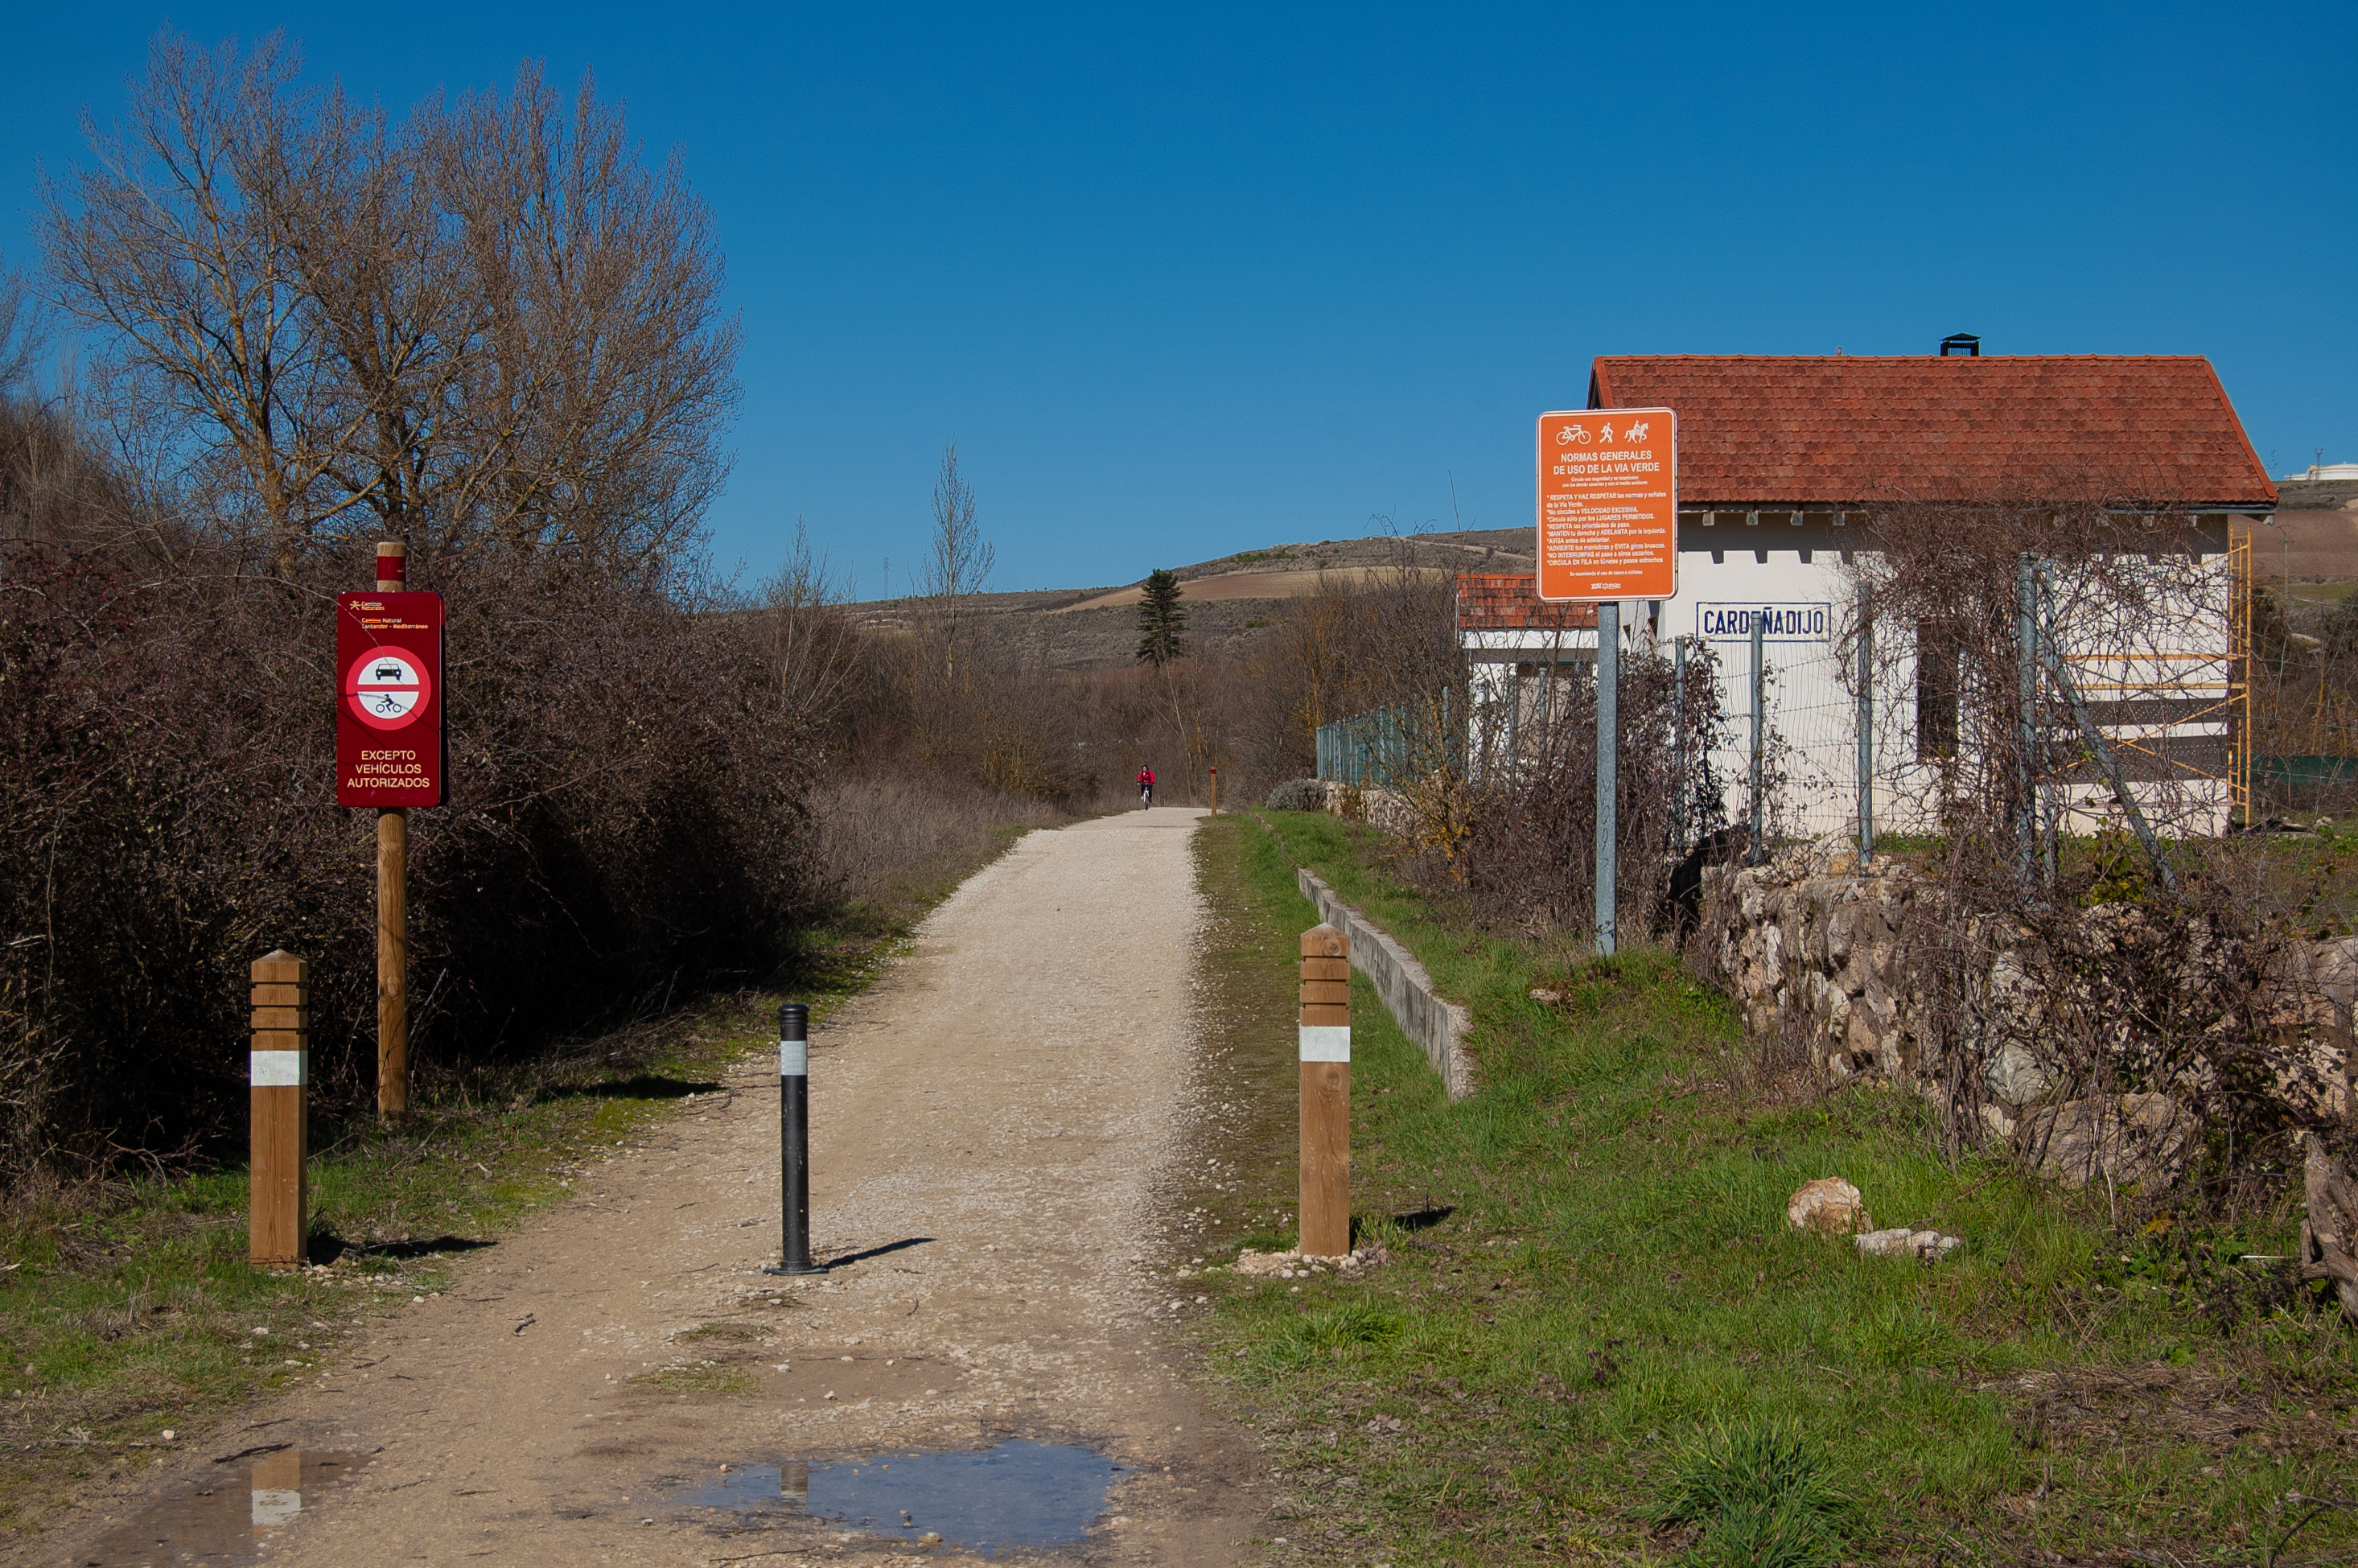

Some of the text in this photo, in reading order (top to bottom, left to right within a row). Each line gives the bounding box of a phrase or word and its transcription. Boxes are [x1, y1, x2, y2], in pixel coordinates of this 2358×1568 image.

[1561, 451, 1652, 463] NORMAS GENERALES
[1553, 466, 1566, 475] DE
[1567, 465, 1586, 475] USO
[1587, 464, 1599, 474] DE
[1601, 463, 1613, 473] LA
[1632, 462, 1660, 472] VERDE
[1704, 607, 1824, 634] CARDÑADIJO
[361, 750, 416, 760] EXCEPTO
[356, 762, 422, 774] VEHÍCULOS
[347, 777, 430, 788] AUTORIZADOS
